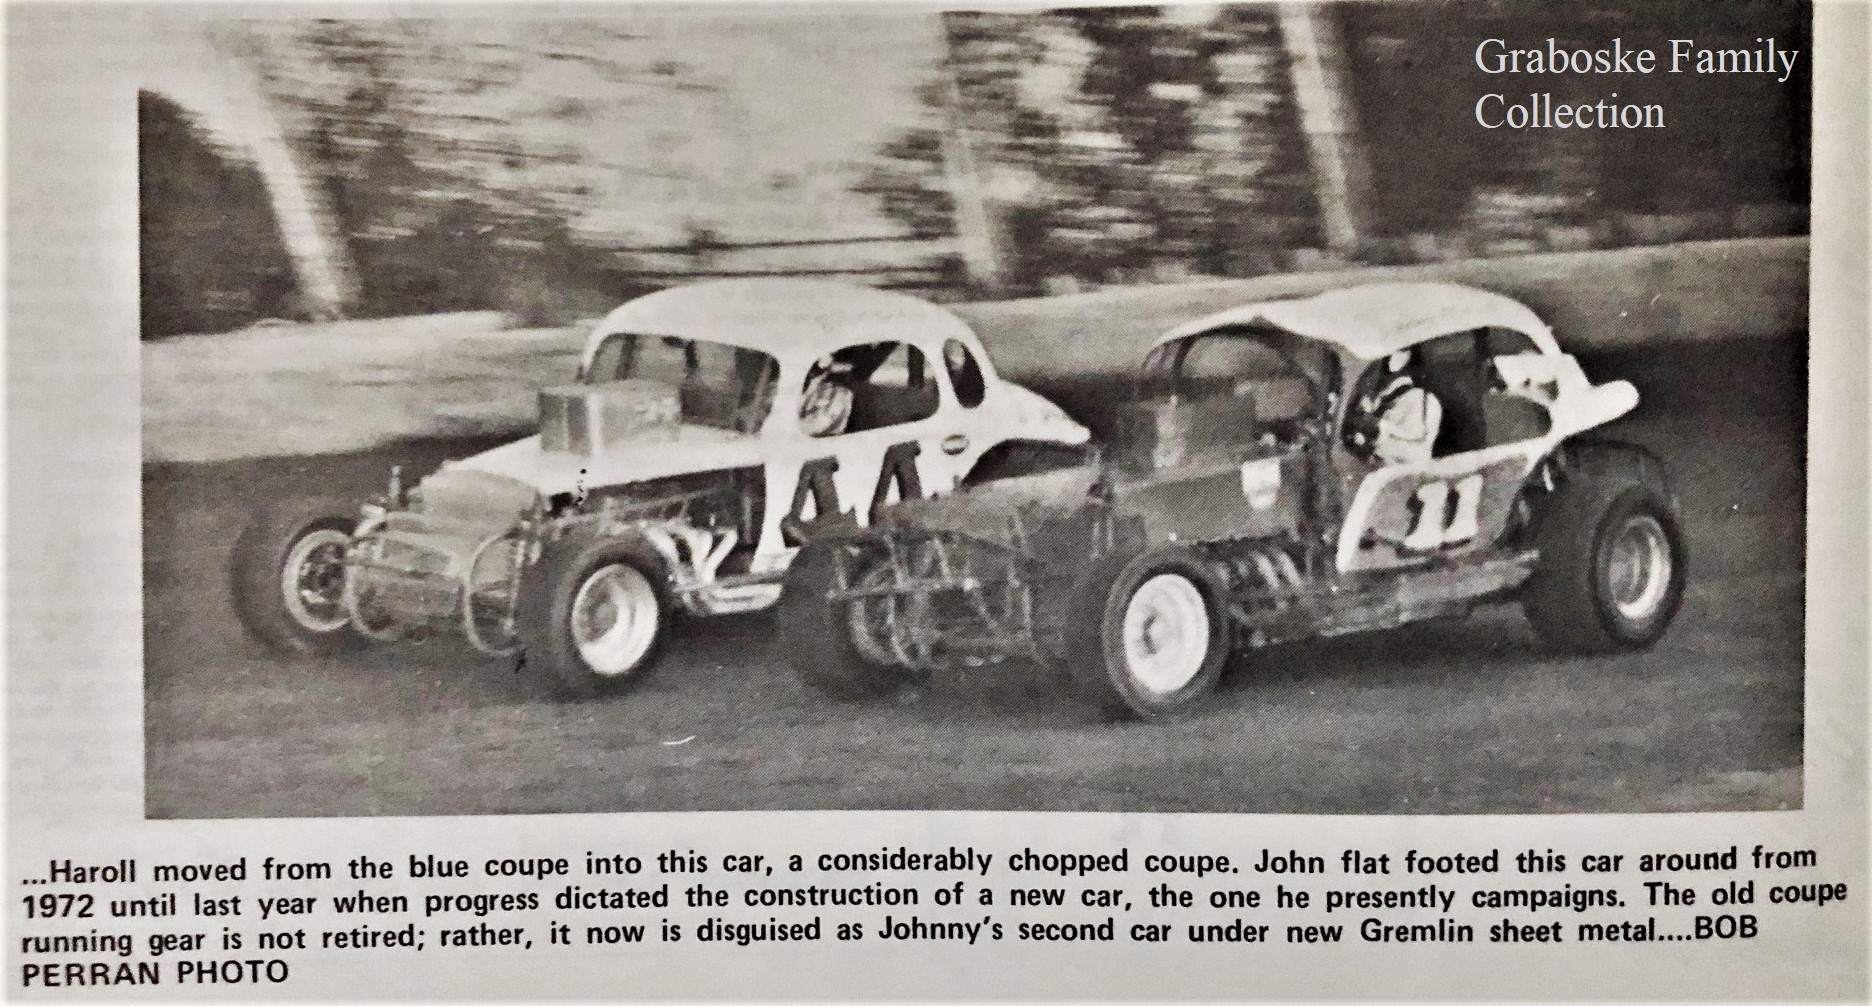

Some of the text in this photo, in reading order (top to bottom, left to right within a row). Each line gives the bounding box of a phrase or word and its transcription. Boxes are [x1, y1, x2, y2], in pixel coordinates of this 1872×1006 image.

[1403, 474, 1484, 550] 11
[21, 844, 1817, 886] ...Haroll moved from the blue coupe into this car, a considerably chopped coupe. John flat footed this car around from
[22, 879, 1848, 921] 1972 until last year when progress dictated the construction of a new car, the one he presently campaigns. The old coupe
[21, 914, 1758, 958] running gear is not retired; rather, it now is disguised as Johnny's second car under new Gremlin sheet metal....BOB
[21, 958, 290, 988] PERRAN PHOTO
